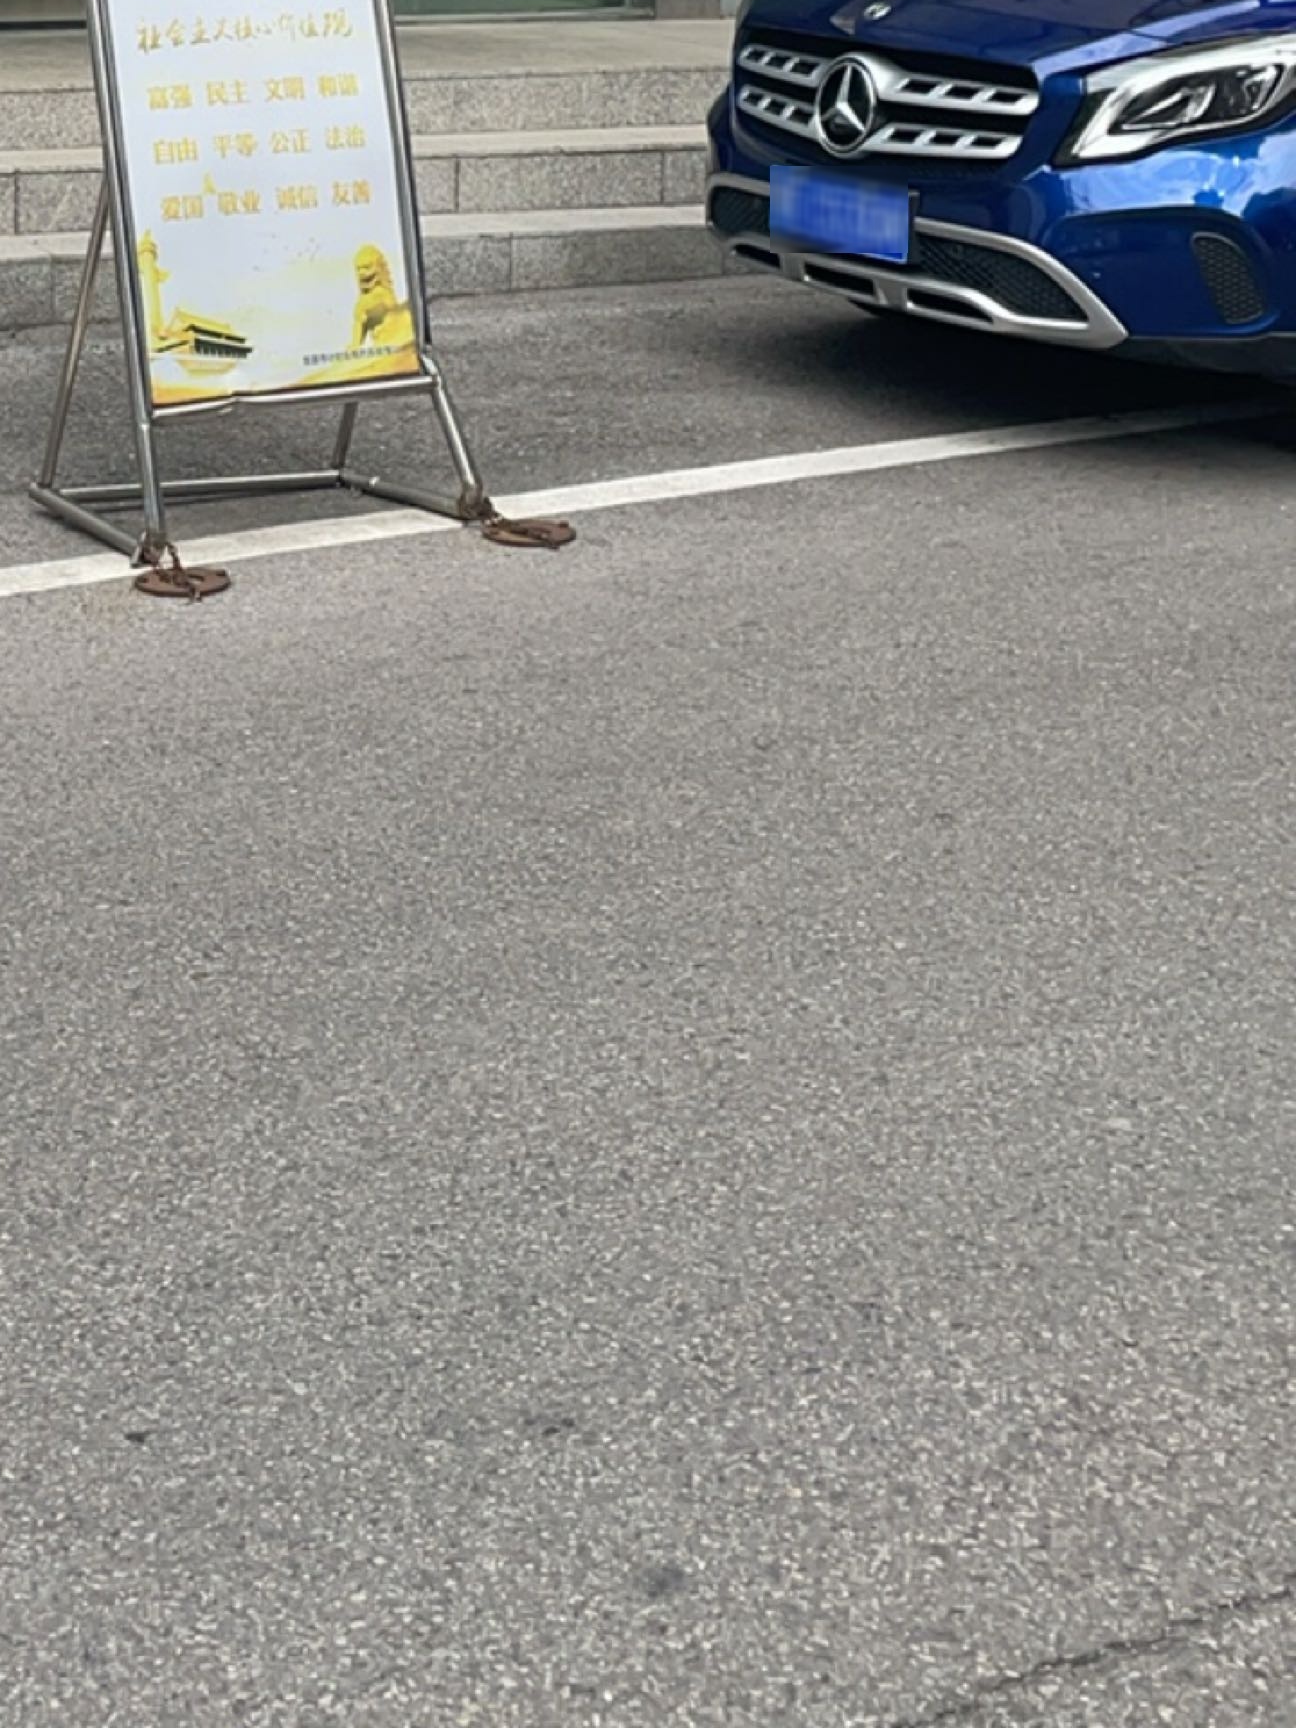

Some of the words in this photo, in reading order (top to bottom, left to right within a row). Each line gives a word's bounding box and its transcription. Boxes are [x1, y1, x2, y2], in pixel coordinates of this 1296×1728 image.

[147, 84, 192, 110] 富强
[206, 79, 250, 106] 民主
[265, 75, 306, 102] 文明
[318, 73, 359, 97] 和谐
[153, 137, 198, 165] 自由
[213, 133, 257, 158] 平等
[271, 129, 312, 154] 公正
[325, 125, 366, 150] 法治
[160, 194, 203, 220] 爱国
[217, 191, 261, 215] 敬业
[276, 185, 318, 210] 诚信
[332, 180, 373, 206] 友善
